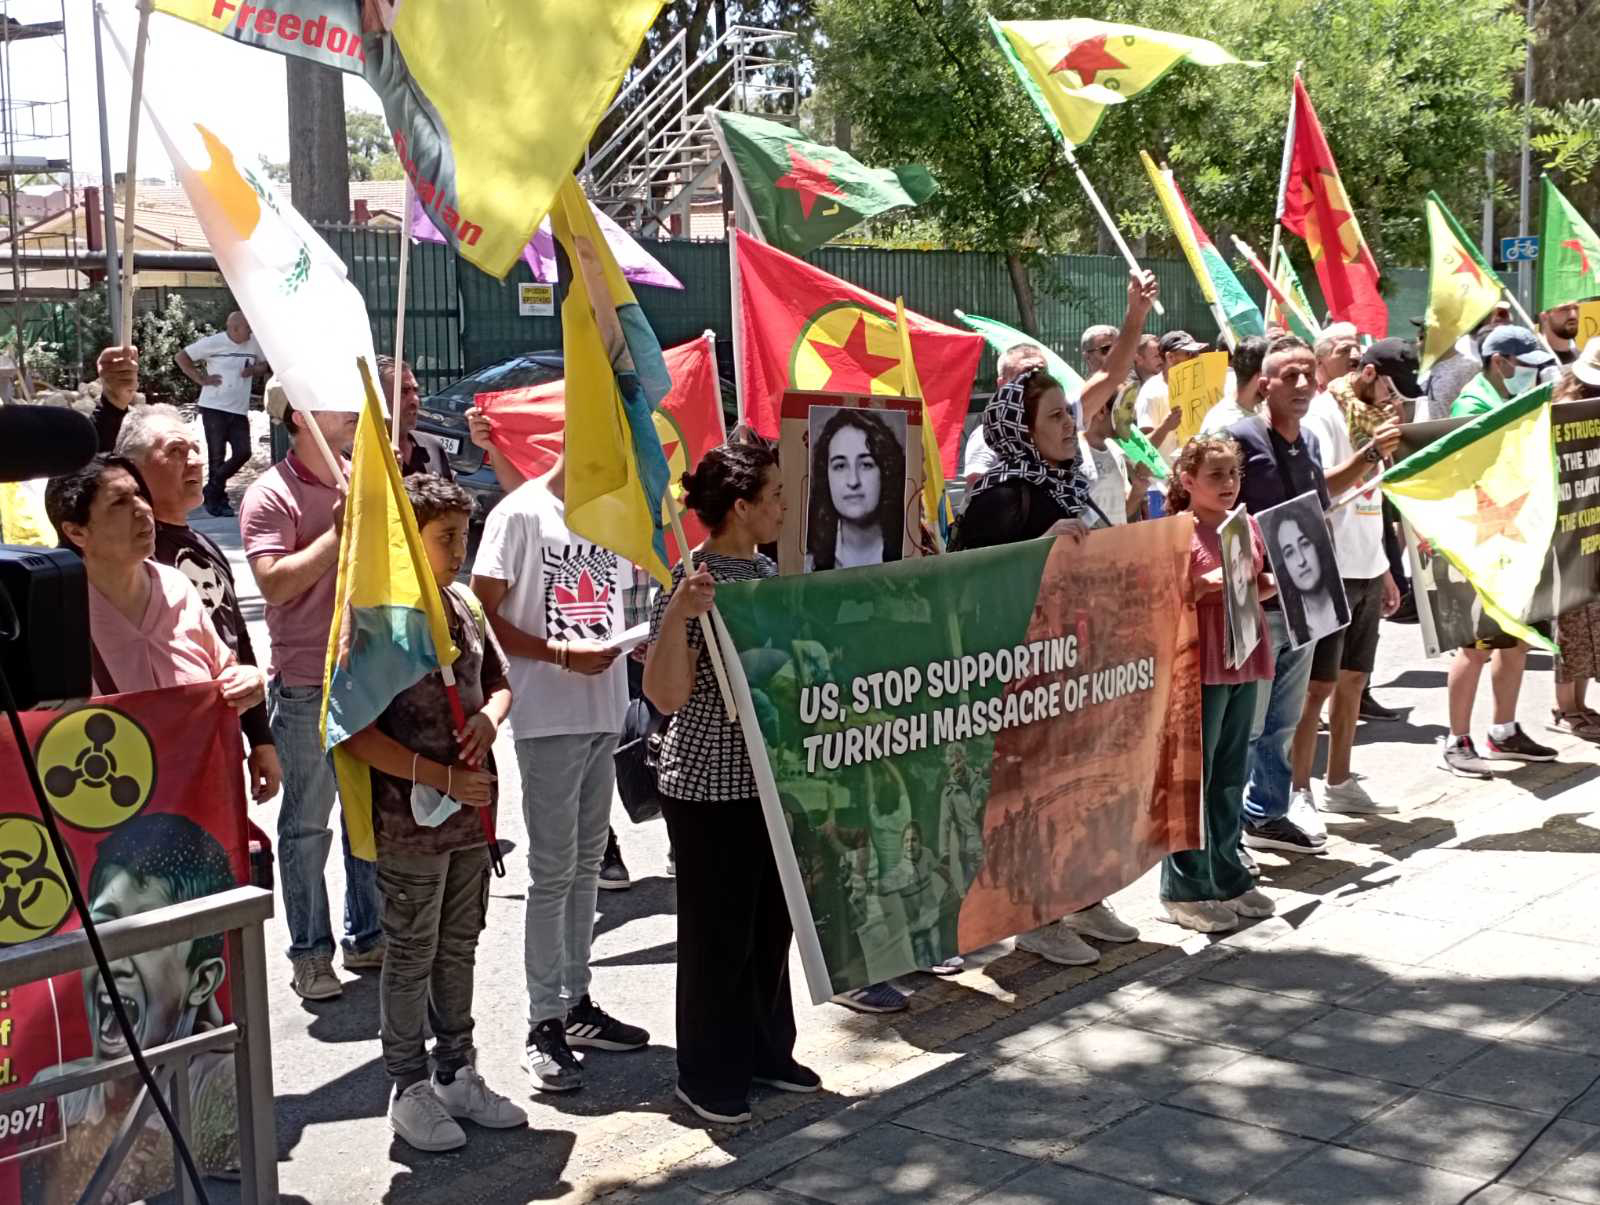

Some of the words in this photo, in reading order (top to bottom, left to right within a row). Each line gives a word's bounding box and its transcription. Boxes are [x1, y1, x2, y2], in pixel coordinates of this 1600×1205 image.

[1562, 451, 1585, 472] THE
[800, 682, 846, 724] US,
[851, 666, 922, 714] STOP
[927, 634, 1078, 698] SUPPORTING
[803, 713, 928, 773] TURKISH
[933, 682, 1061, 746] MASSACRE
[1064, 674, 1089, 712] OF
[1092, 656, 1155, 705] KURDS!
